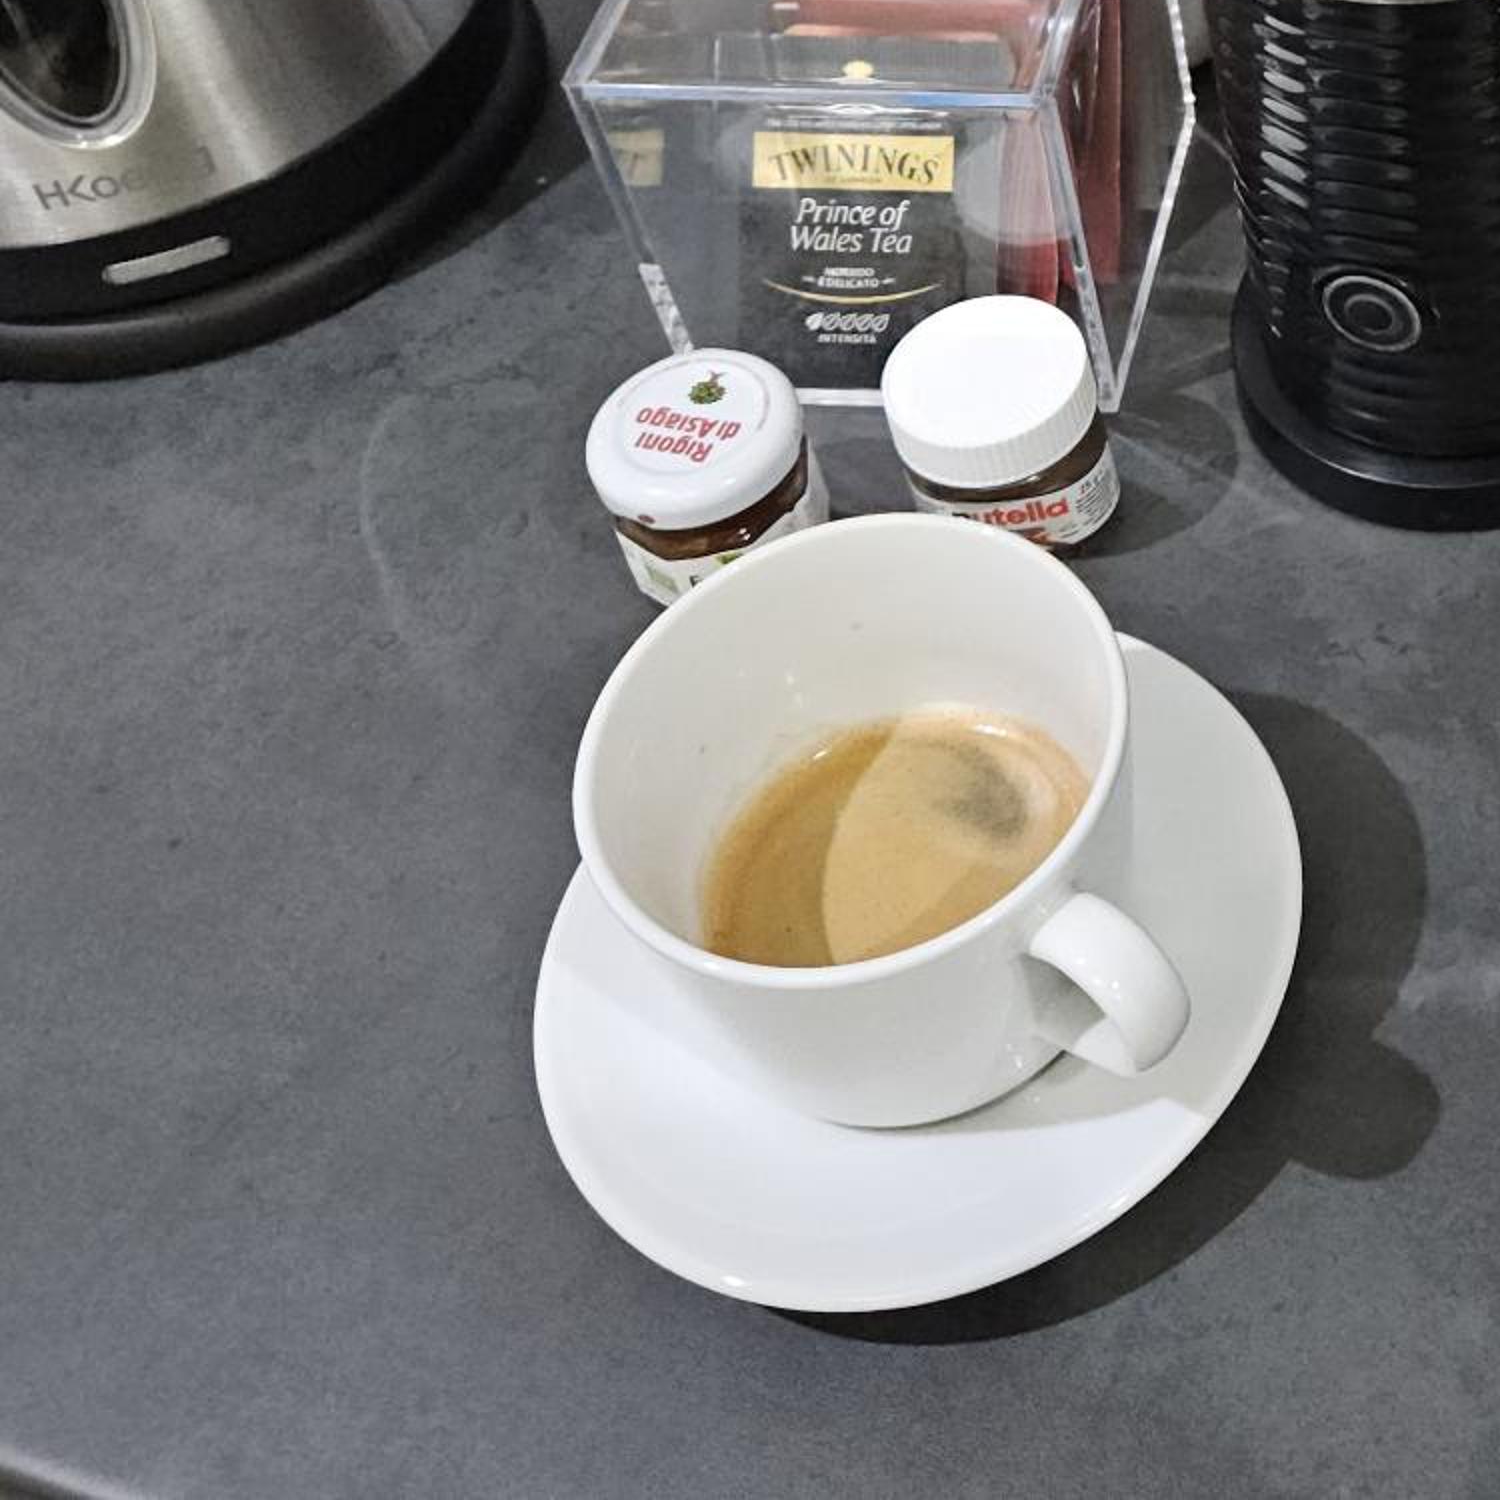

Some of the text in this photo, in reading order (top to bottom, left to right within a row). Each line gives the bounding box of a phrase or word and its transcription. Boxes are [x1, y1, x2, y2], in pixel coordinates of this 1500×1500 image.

[767, 143, 940, 186] TWININGS
[796, 197, 911, 232] Prince of
[790, 225, 914, 253] Wales Tea
[634, 432, 714, 463] Rigoni
[952, 497, 1070, 527] utella
